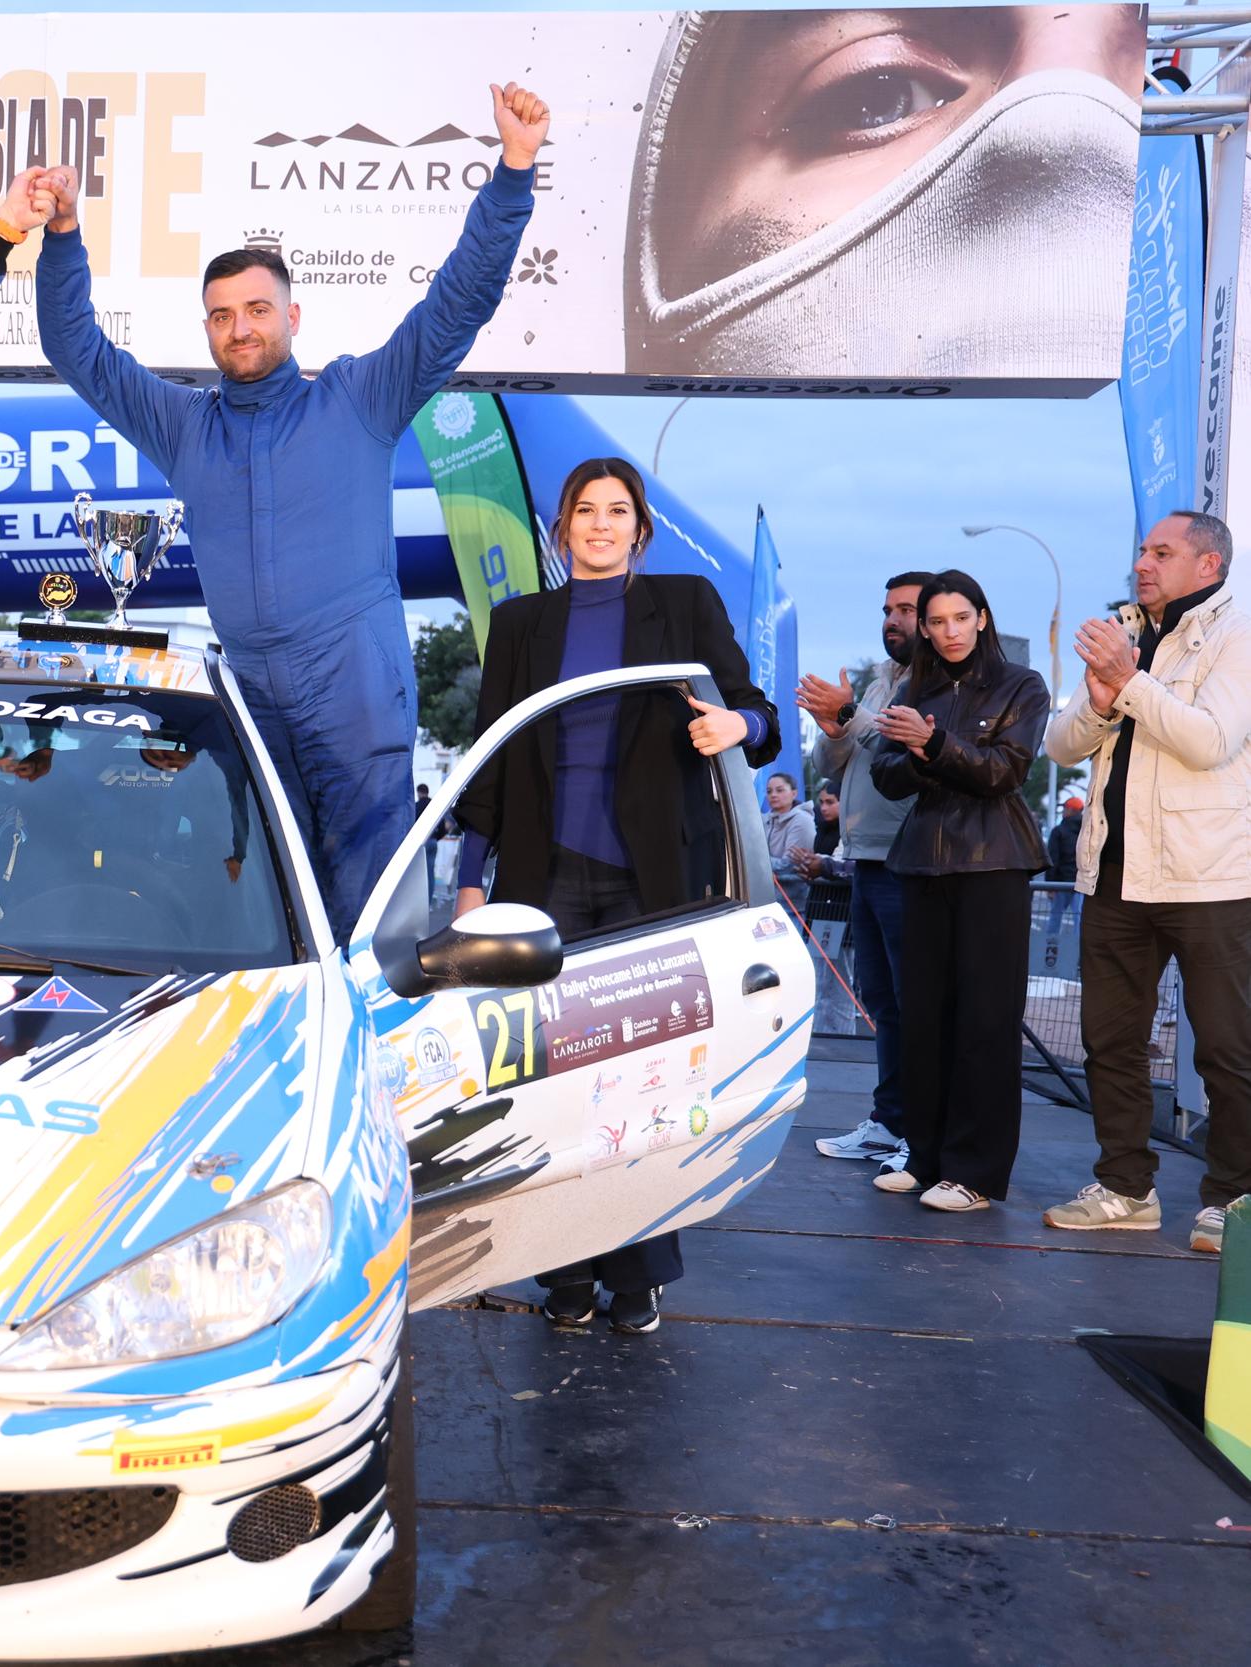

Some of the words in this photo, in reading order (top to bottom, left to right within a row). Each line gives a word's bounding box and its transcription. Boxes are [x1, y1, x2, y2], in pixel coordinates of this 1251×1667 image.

[60, 98, 106, 198] DE
[251, 160, 555, 191] LANZAROE
[324, 204, 342, 214] LA
[351, 204, 383, 214] ISLA
[392, 205, 468, 215] DIFERENT
[290, 249, 364, 266] Cabildo
[371, 250, 395, 266] de
[290, 269, 387, 285] Lanzarote
[645, 382, 952, 397] Orvecame
[1203, 285, 1225, 513] vecame
[537, 983, 561, 1022] 47
[560, 980, 590, 999] Rallye
[589, 969, 632, 990] Orvecame
[632, 963, 647, 979] Isla
[648, 960, 659, 973] de
[659, 950, 700, 969] Lanzarote
[644, 982, 654, 992] de
[634, 1018, 651, 1030] Cabildo
[634, 1026, 658, 1038] Lanzarote
[476, 990, 536, 1087] 27
[553, 1031, 613, 1059] LANZAROTE
[423, 1041, 443, 1063] FCA
[119, 1444, 214, 1470] PIRELLI
